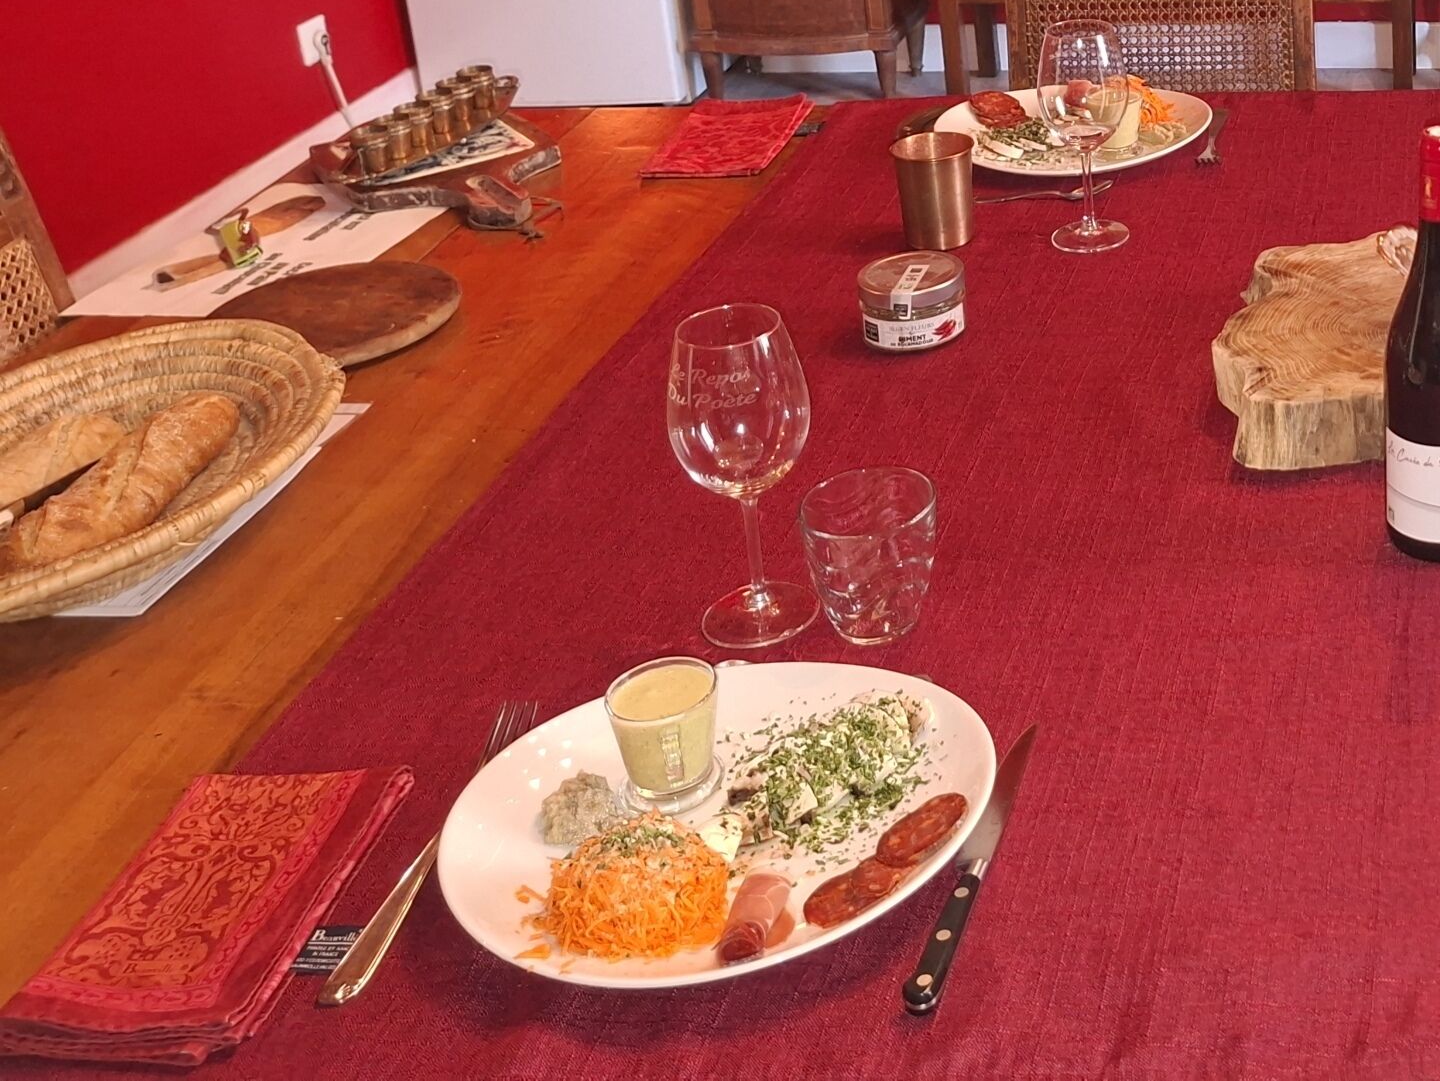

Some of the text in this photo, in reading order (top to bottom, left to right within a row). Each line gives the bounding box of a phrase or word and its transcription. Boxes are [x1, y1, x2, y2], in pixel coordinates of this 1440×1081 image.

[670, 362, 752, 390] Le Repos
[667, 381, 758, 410] Du Poète
